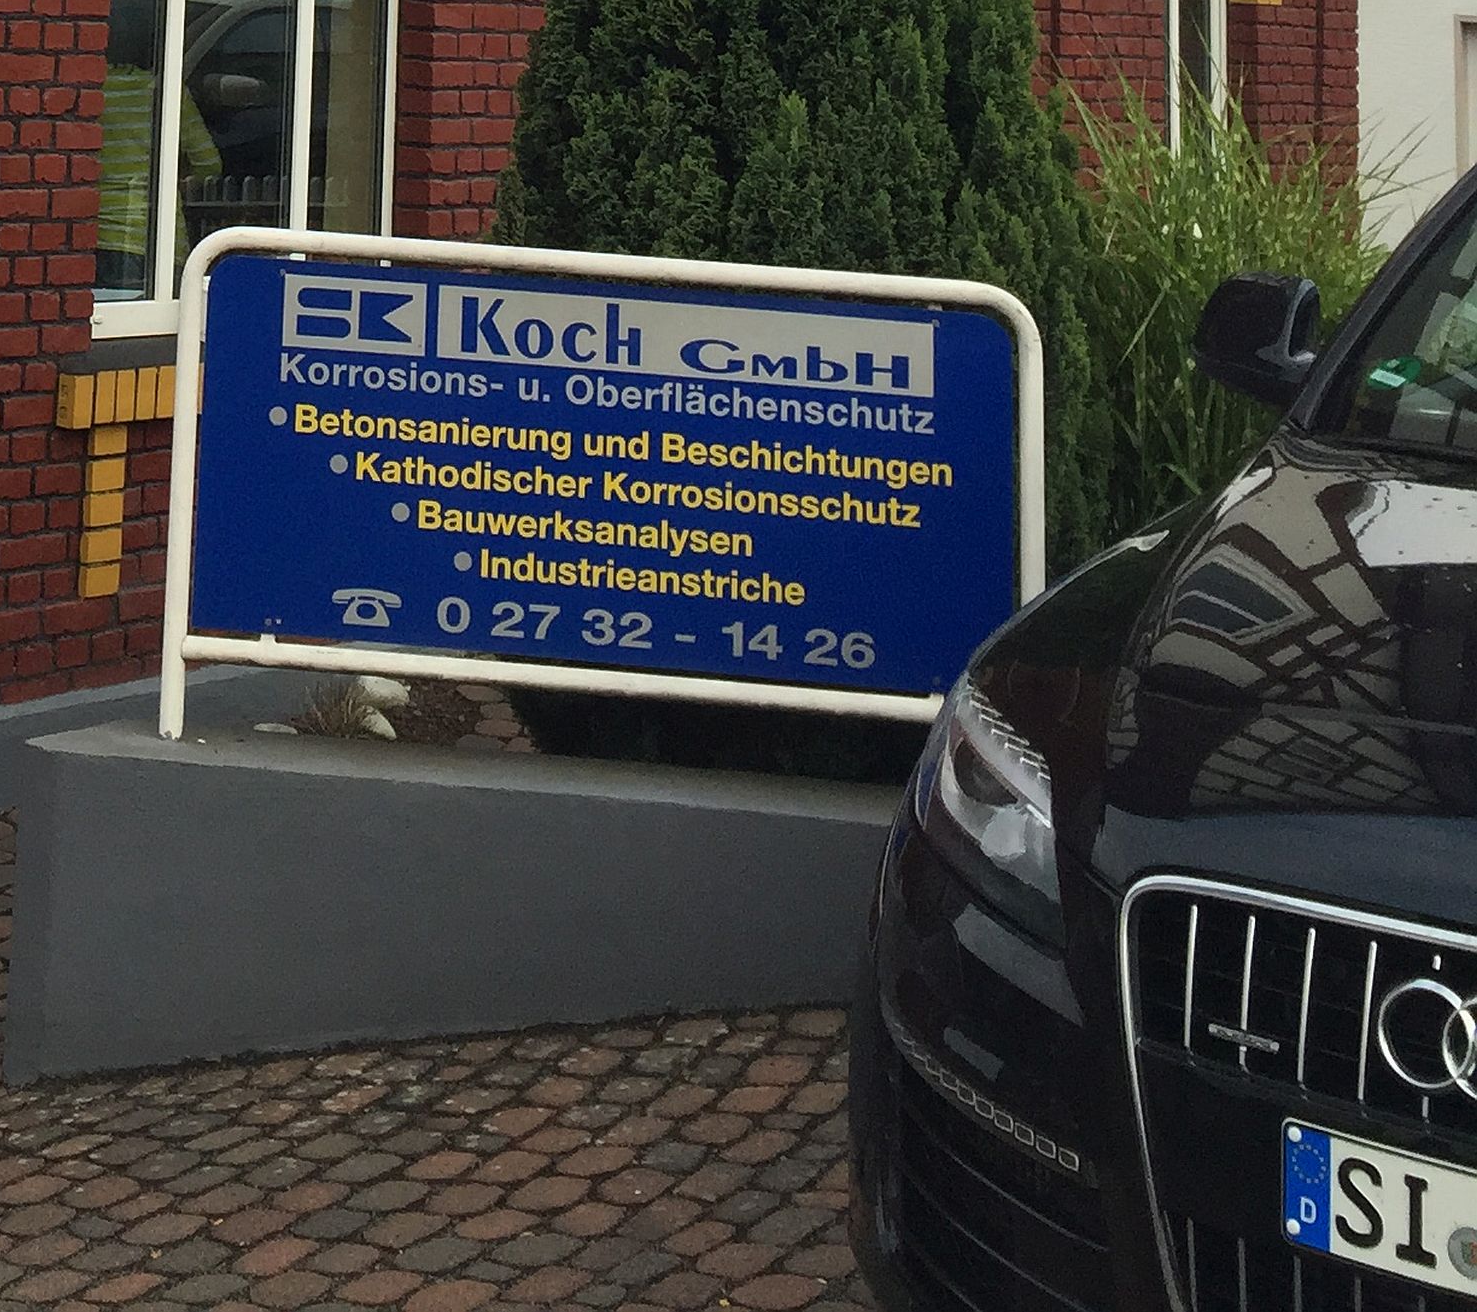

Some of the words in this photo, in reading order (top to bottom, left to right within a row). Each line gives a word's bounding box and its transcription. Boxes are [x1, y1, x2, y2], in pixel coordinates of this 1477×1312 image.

[460, 294, 642, 367] Koch
[679, 338, 910, 390] GmbH
[280, 352, 504, 398] Korrosions-
[518, 378, 551, 402] u.
[565, 374, 935, 435] Oberflächenschutz
[294, 403, 572, 460] Betonsanierung
[584, 431, 650, 461] und
[661, 432, 953, 489] Beschichtungen
[356, 451, 593, 499] Kathodischer
[603, 471, 922, 528] Korrosionsschutz
[418, 499, 753, 557] Bauwerksanalysen
[480, 548, 806, 606] Industrieanstriche
[436, 596, 471, 634] 0
[490, 601, 561, 640] 27
[581, 608, 653, 649] 32
[722, 621, 783, 660] 14
[803, 628, 876, 669] 26
[1300, 1196, 1317, 1224] D
[1335, 1157, 1438, 1269] SI
